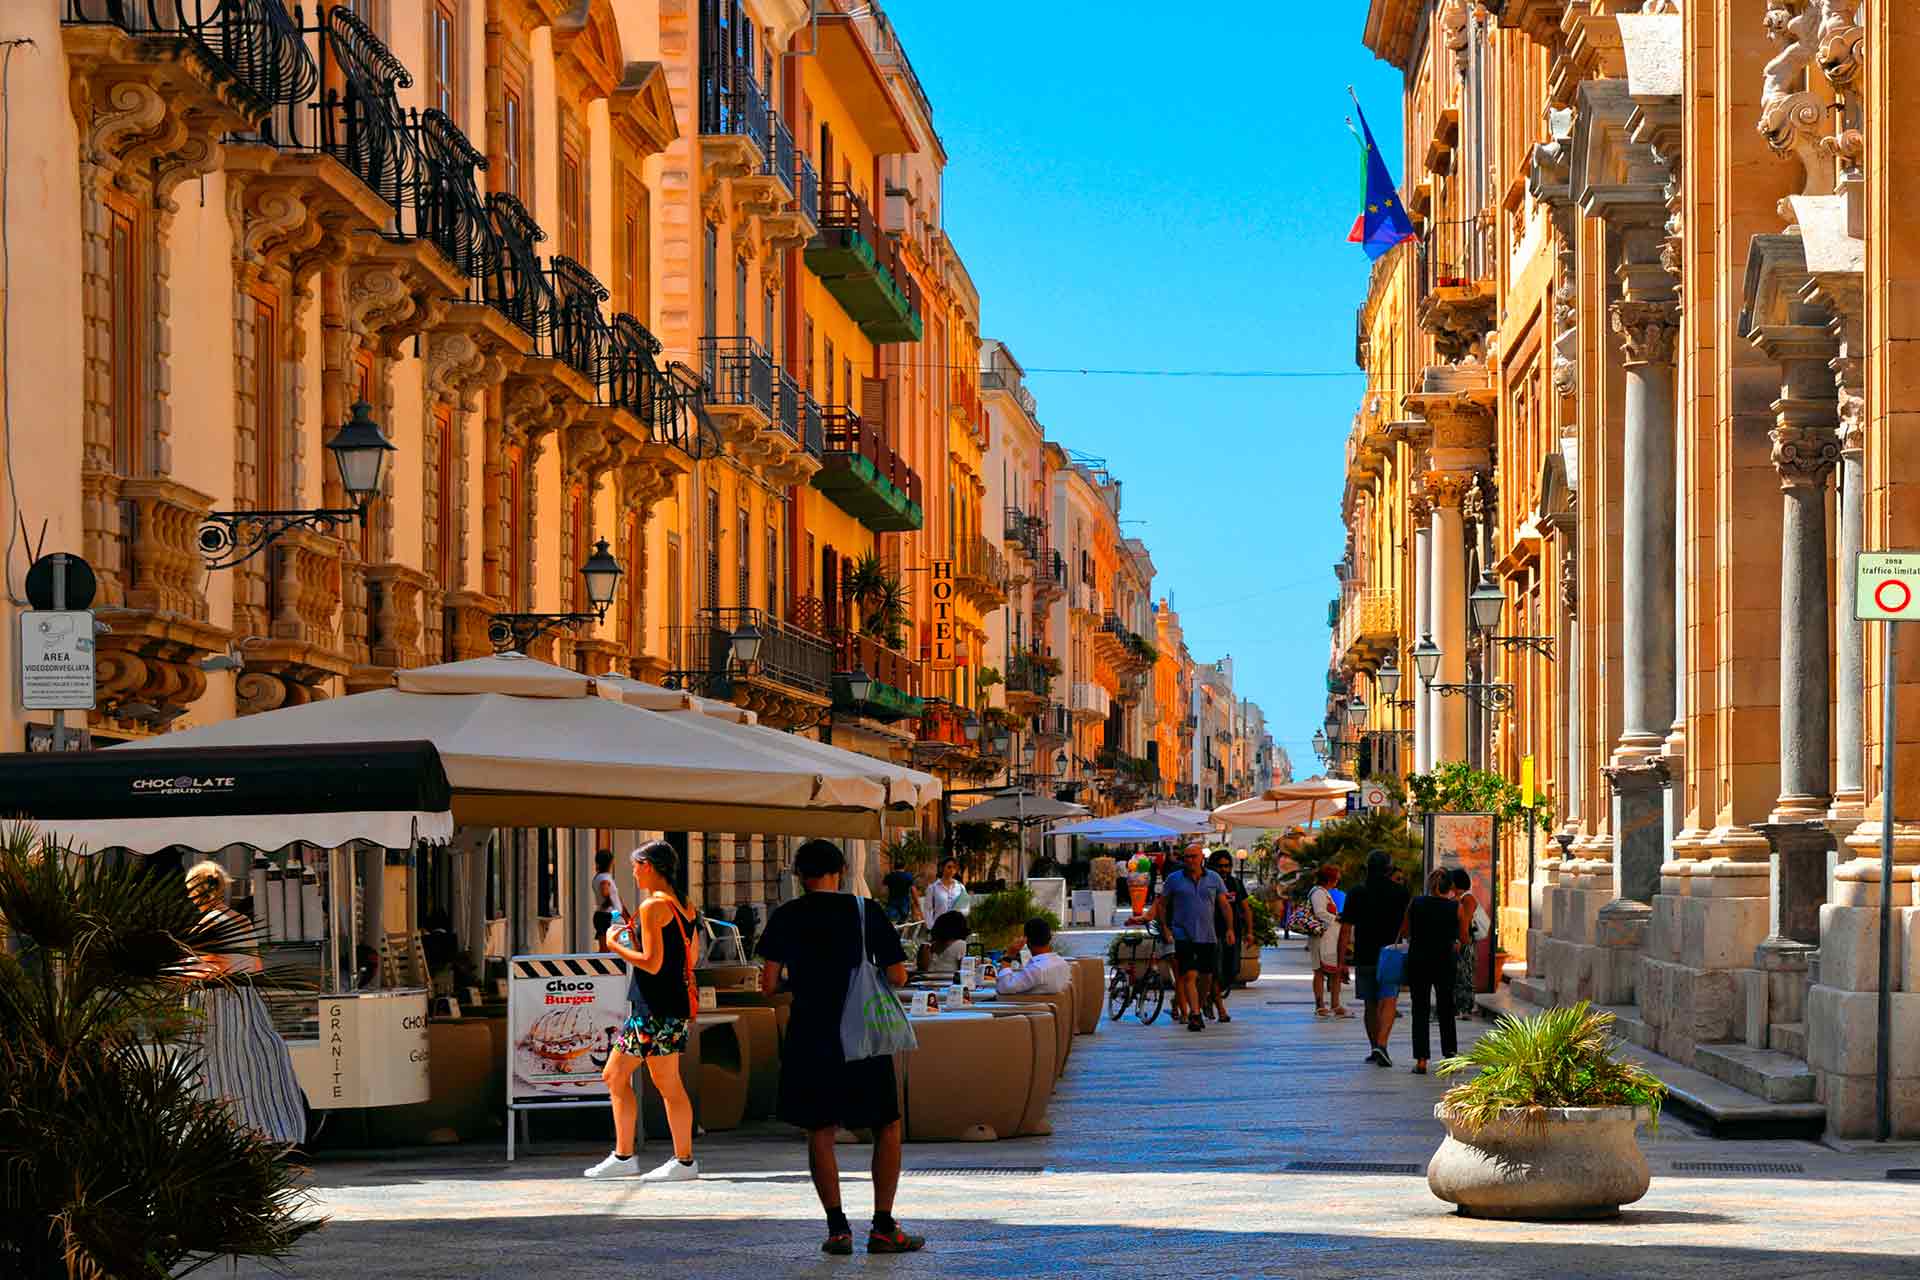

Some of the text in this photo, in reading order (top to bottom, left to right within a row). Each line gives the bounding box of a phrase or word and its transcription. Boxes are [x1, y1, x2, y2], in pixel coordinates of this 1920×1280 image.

[1862, 566, 1892, 575] traffico
[933, 561, 952, 660] HOTEL
[43, 652, 70, 661] AREA
[546, 979, 595, 992] Choco
[544, 994, 596, 1005] Burger
[329, 1004, 343, 1098] GRANITE
